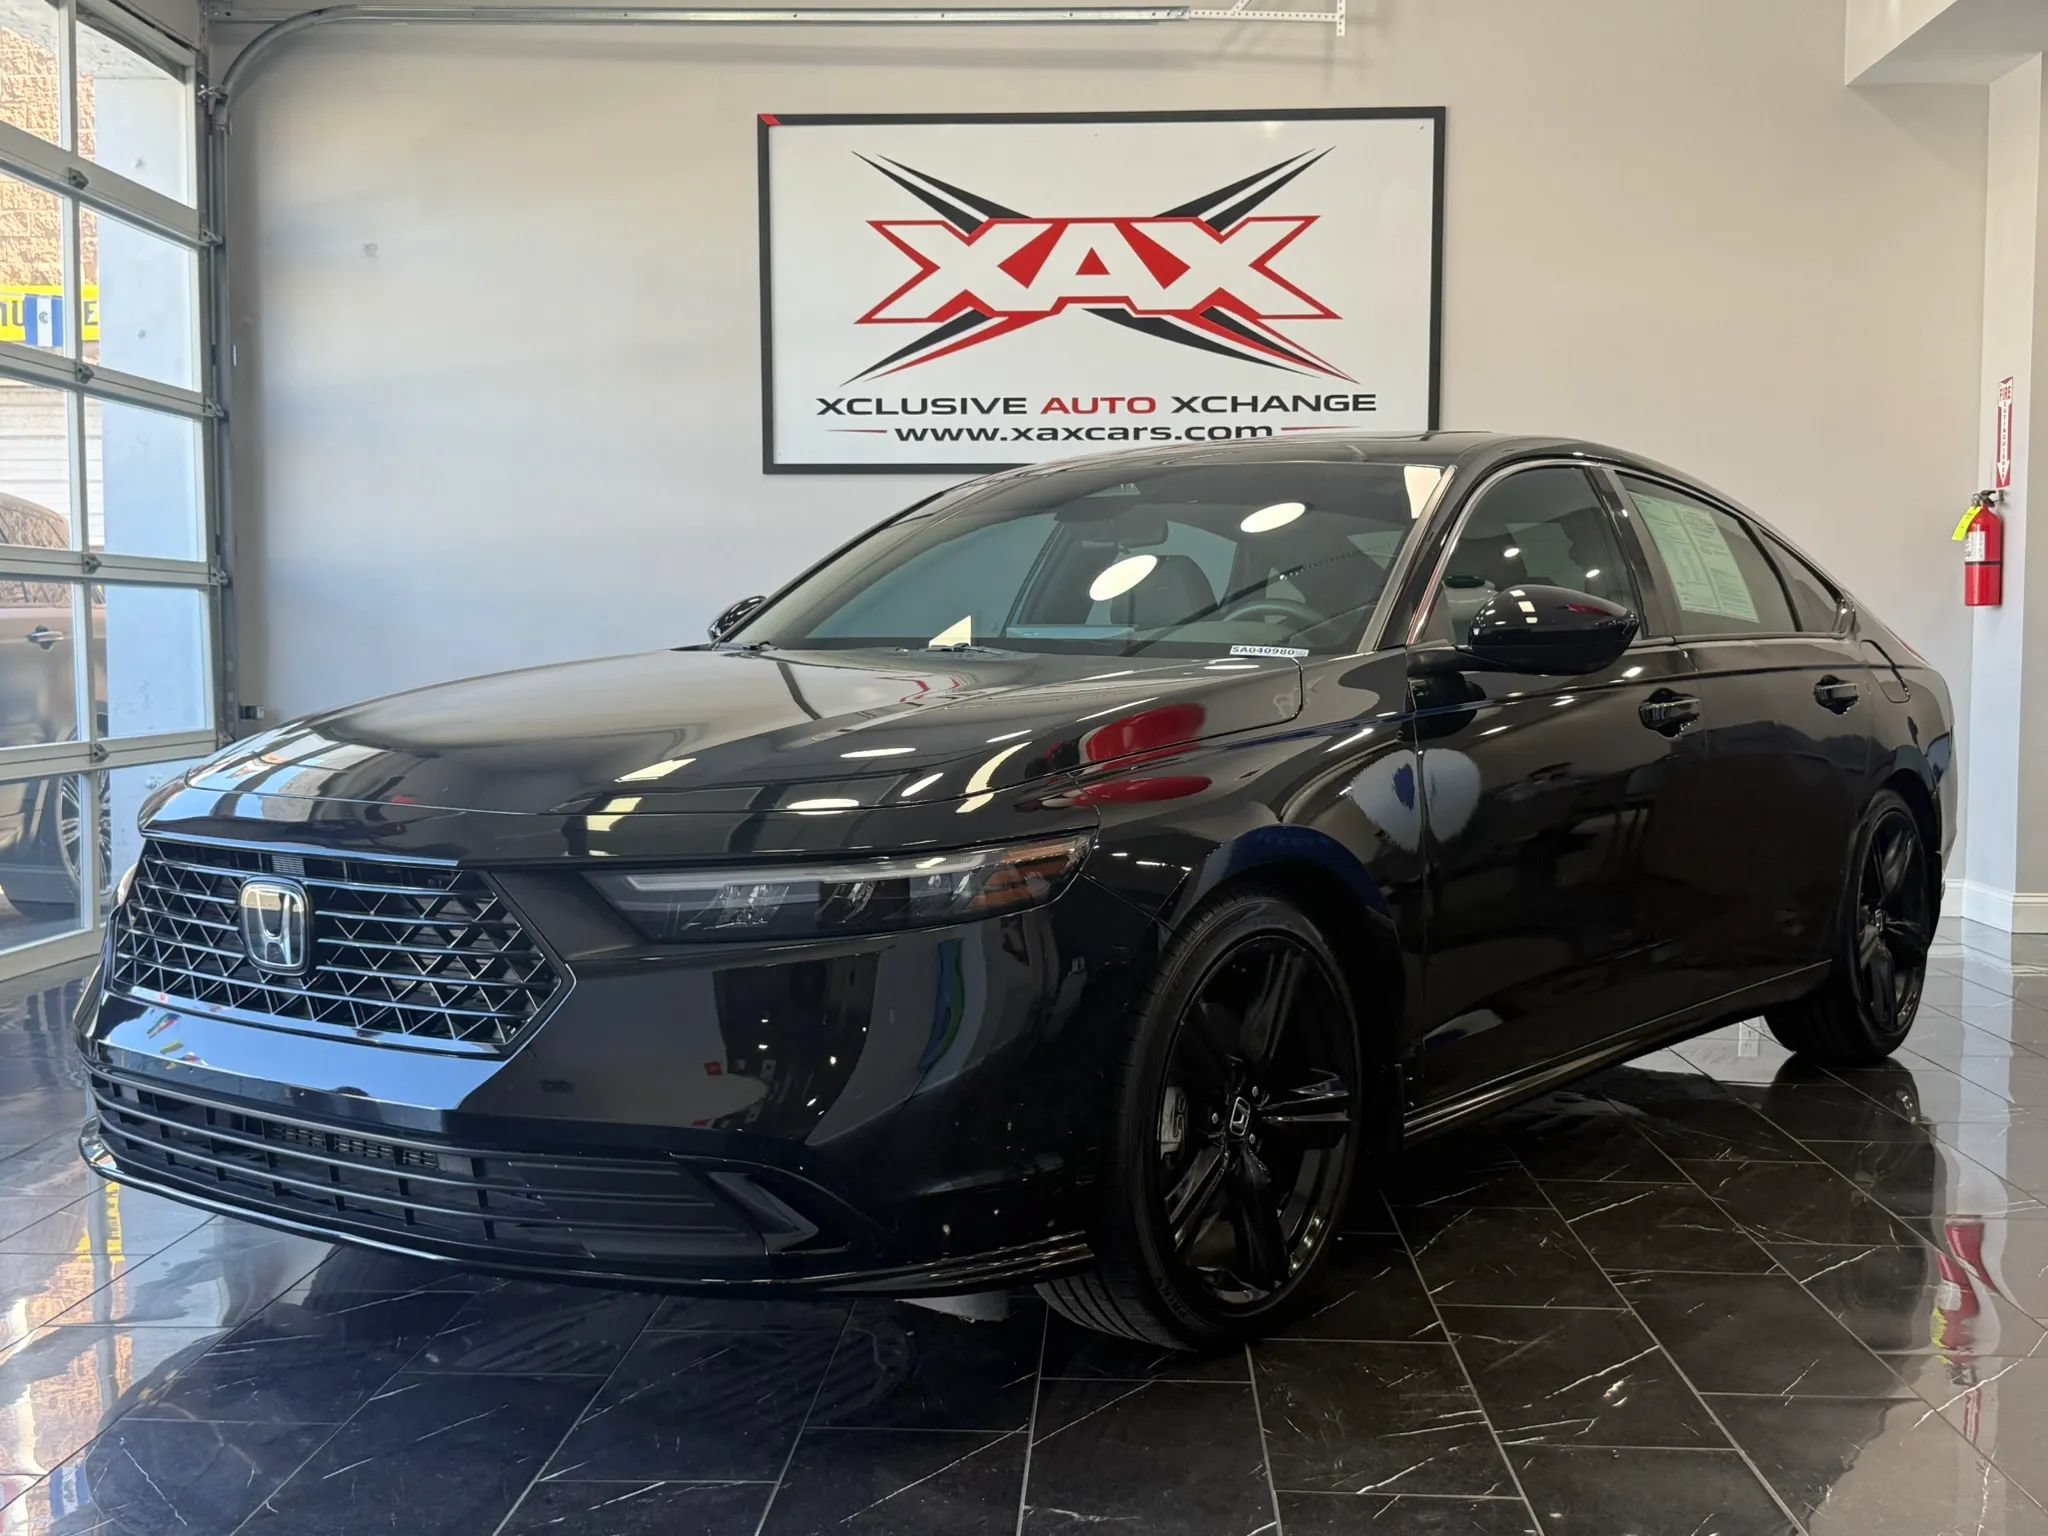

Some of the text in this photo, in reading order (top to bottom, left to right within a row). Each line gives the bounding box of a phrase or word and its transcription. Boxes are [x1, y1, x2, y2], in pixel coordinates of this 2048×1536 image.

[854, 215, 1343, 324] XAX
[816, 394, 1377, 415] XCLUSIVE AUTO XCHANGE
[894, 426, 1273, 441] www.xaxcars.com
